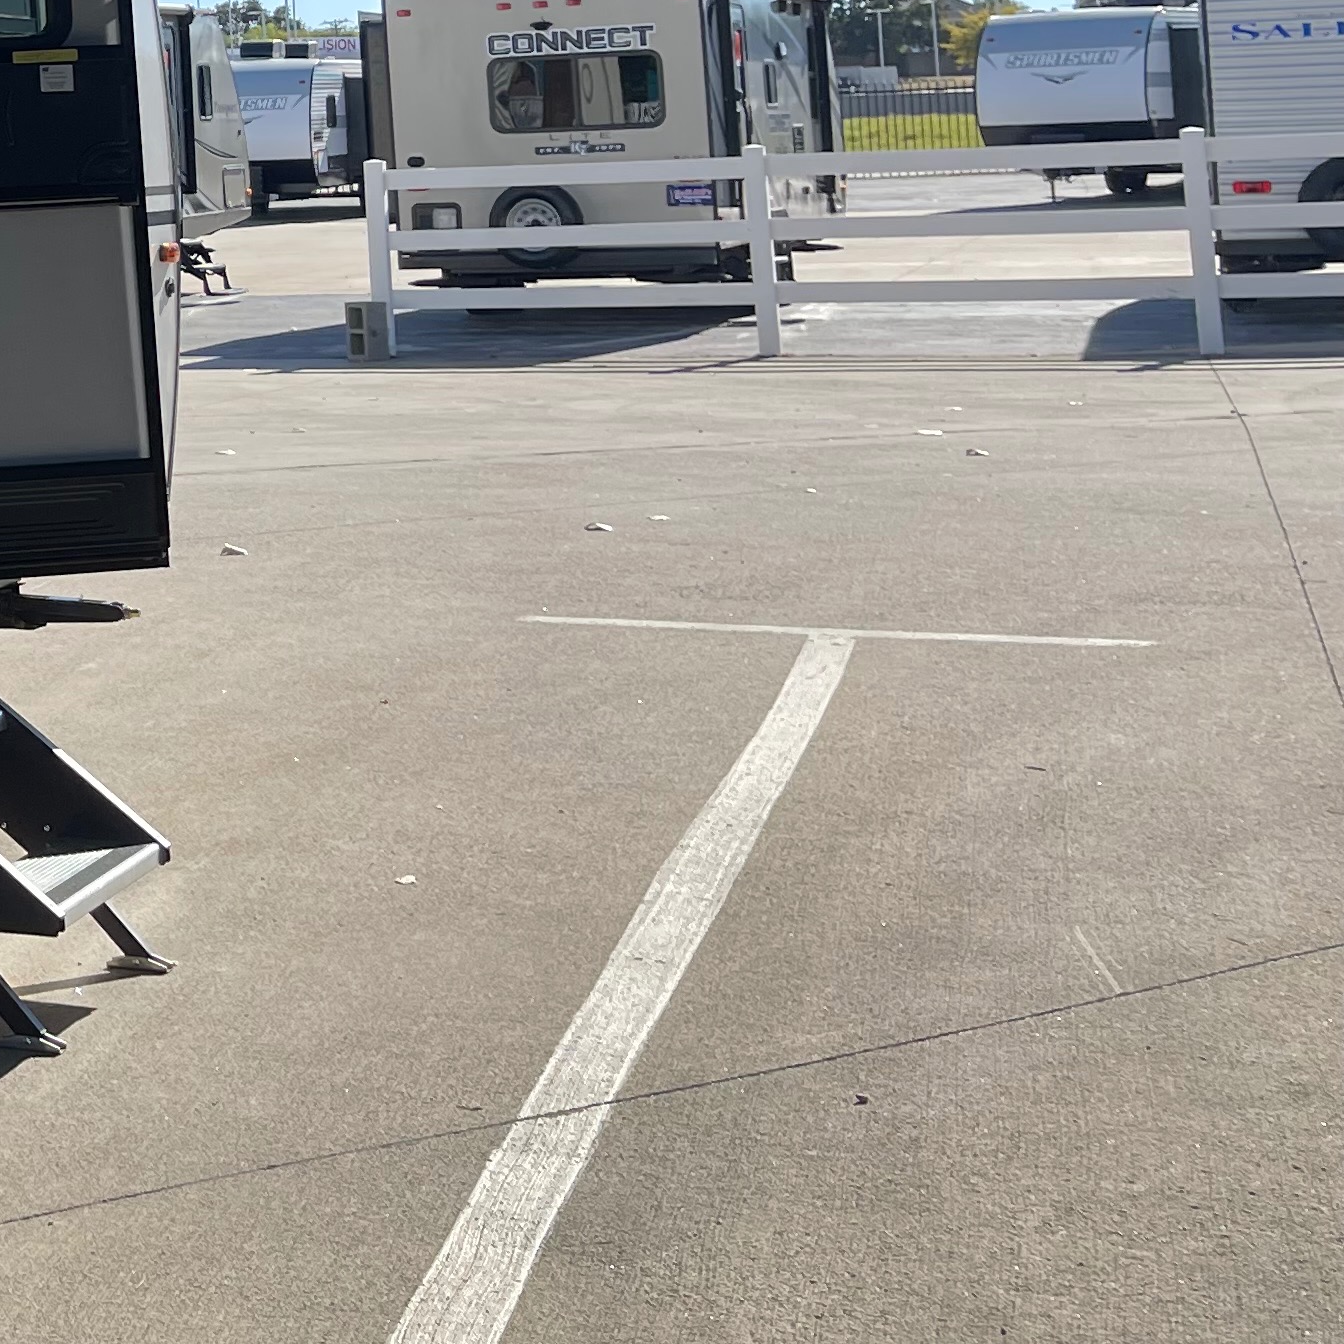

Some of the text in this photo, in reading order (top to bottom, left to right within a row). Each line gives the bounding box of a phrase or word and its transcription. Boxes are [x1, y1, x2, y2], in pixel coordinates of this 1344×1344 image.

[487, 24, 655, 56] CONNECT
[1231, 21, 1344, 41] SAL
[319, 39, 357, 52] ISION
[1005, 50, 1120, 69] SPORTSMEN
